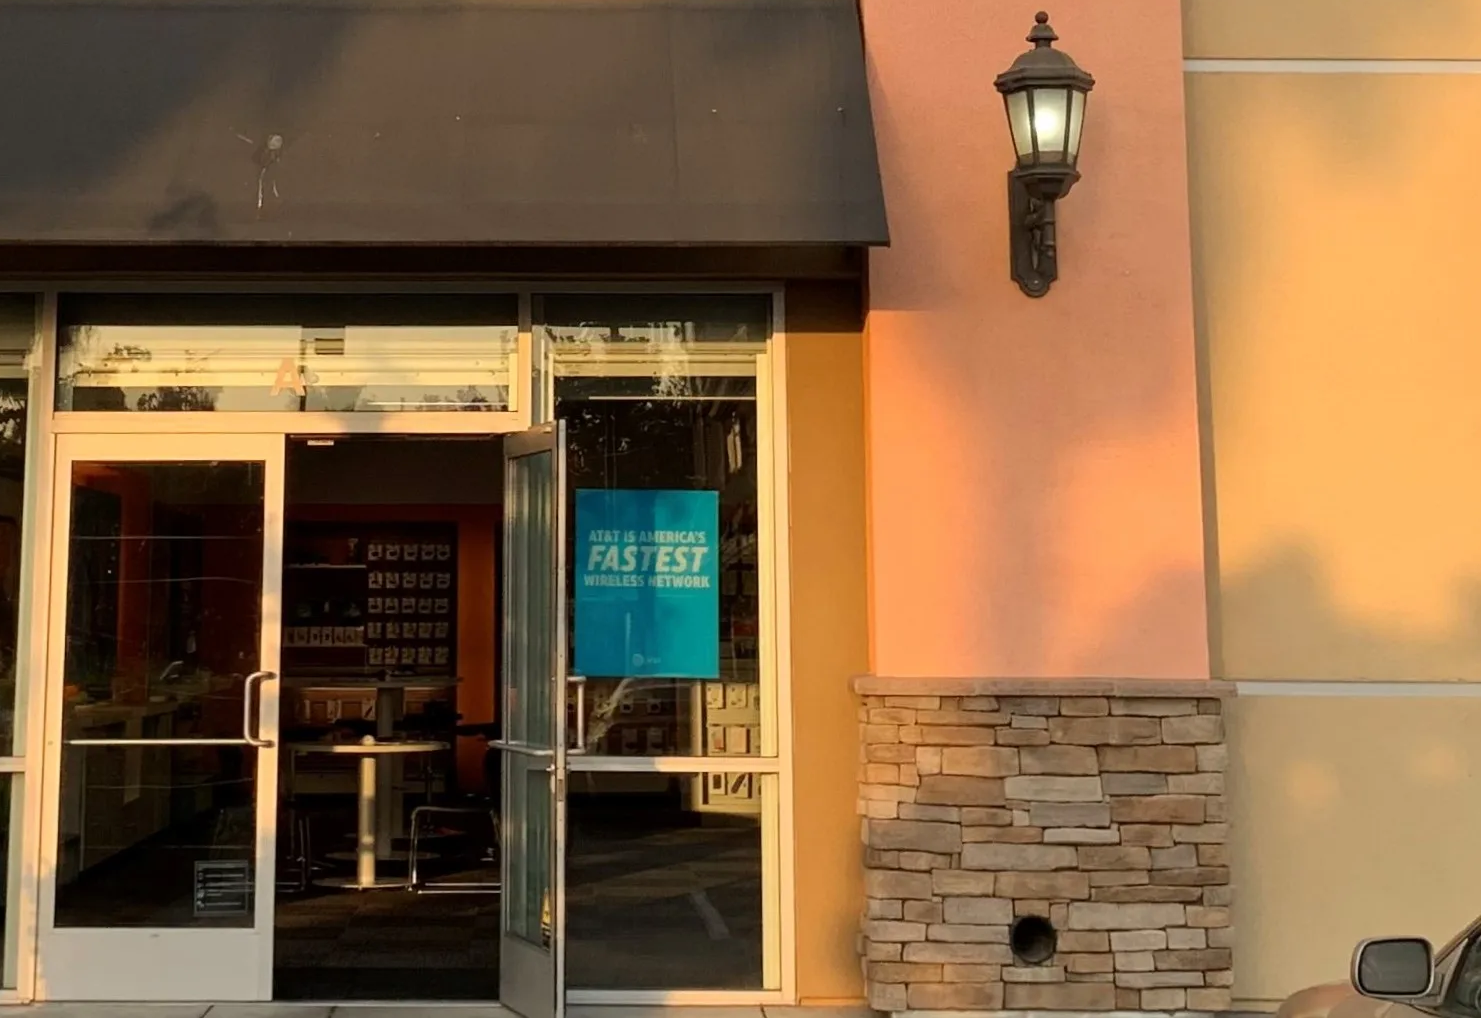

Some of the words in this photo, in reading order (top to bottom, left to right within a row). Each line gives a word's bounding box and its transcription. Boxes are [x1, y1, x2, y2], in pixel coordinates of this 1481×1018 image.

[270, 357, 307, 397] A
[588, 529, 620, 543] AT&T
[623, 530, 636, 543] IS
[639, 530, 706, 544] AMERICA'S
[588, 545, 708, 572] FASTEST
[583, 573, 645, 587] WIRELESS
[647, 574, 711, 588] NETWORK
